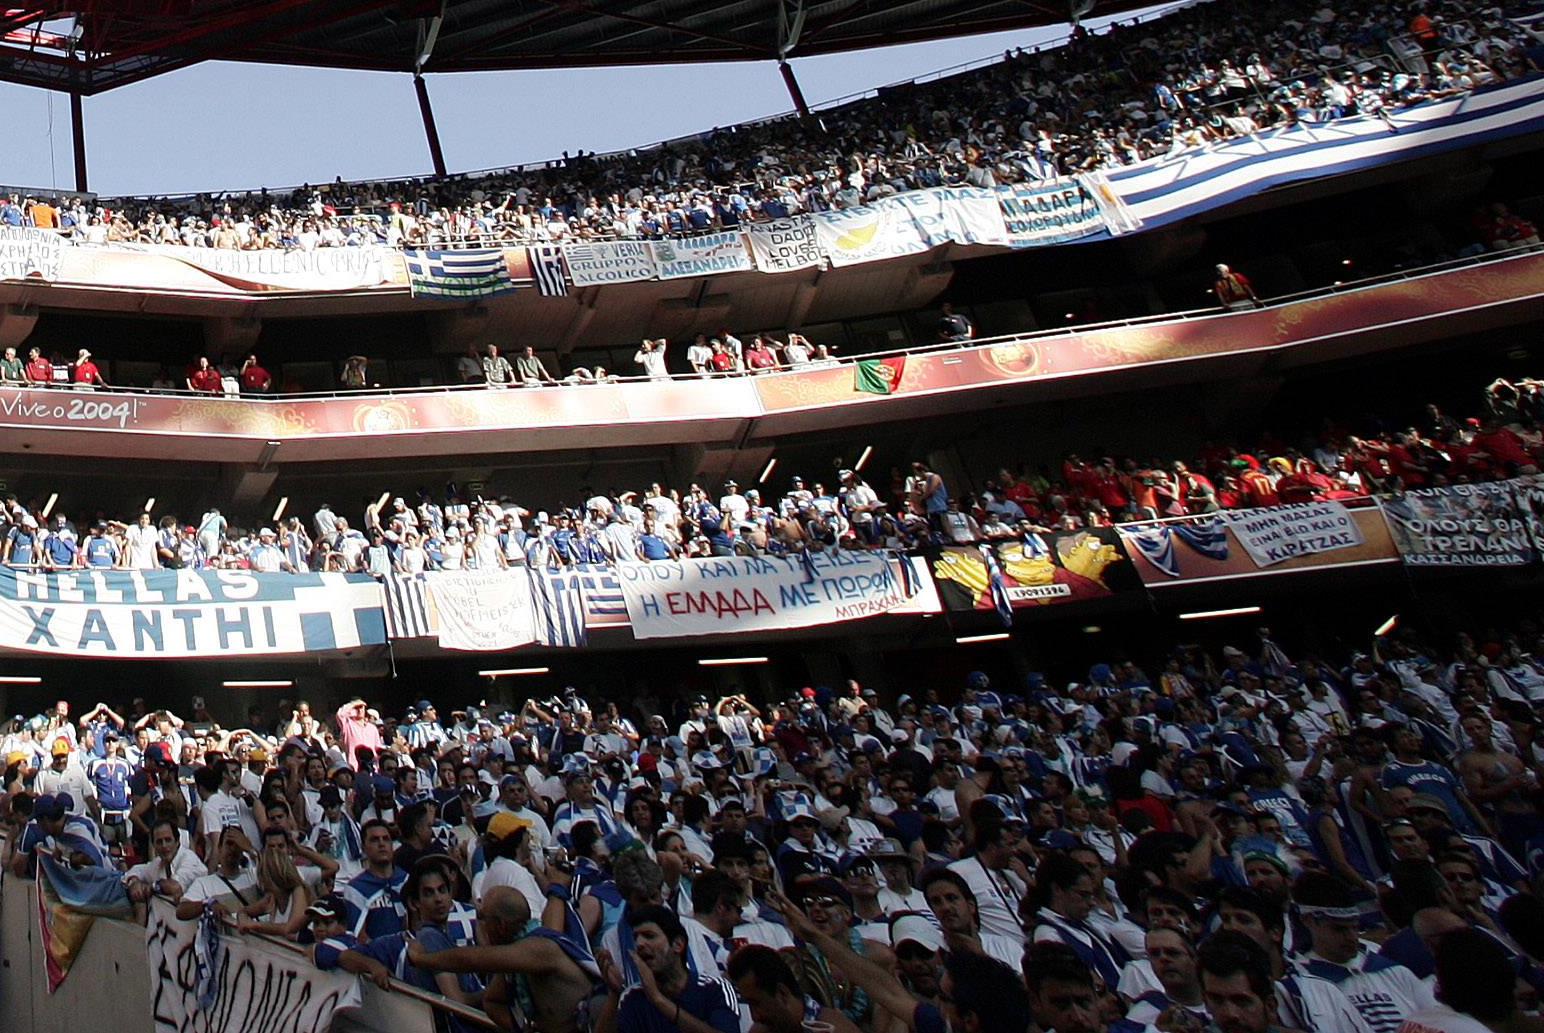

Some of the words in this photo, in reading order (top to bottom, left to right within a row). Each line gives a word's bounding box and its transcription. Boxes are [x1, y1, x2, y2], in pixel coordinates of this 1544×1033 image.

[1, 393, 51, 419] Vive
[53, 407, 65, 419] o
[623, 563, 685, 581] ΟΠΟΥ
[696, 560, 738, 579] ΚΑΙ
[744, 556, 778, 576] ΝΑ
[1403, 554, 1526, 565] ΚΑΣΣΑΝΔΡΕΙΑ
[15, 569, 261, 602] HELLAS
[640, 593, 661, 618] Η
[665, 587, 777, 619] ΕΛΛΑΔΑ
[779, 581, 821, 608] ΜΕ
[25, 605, 278, 652] XANTHI
